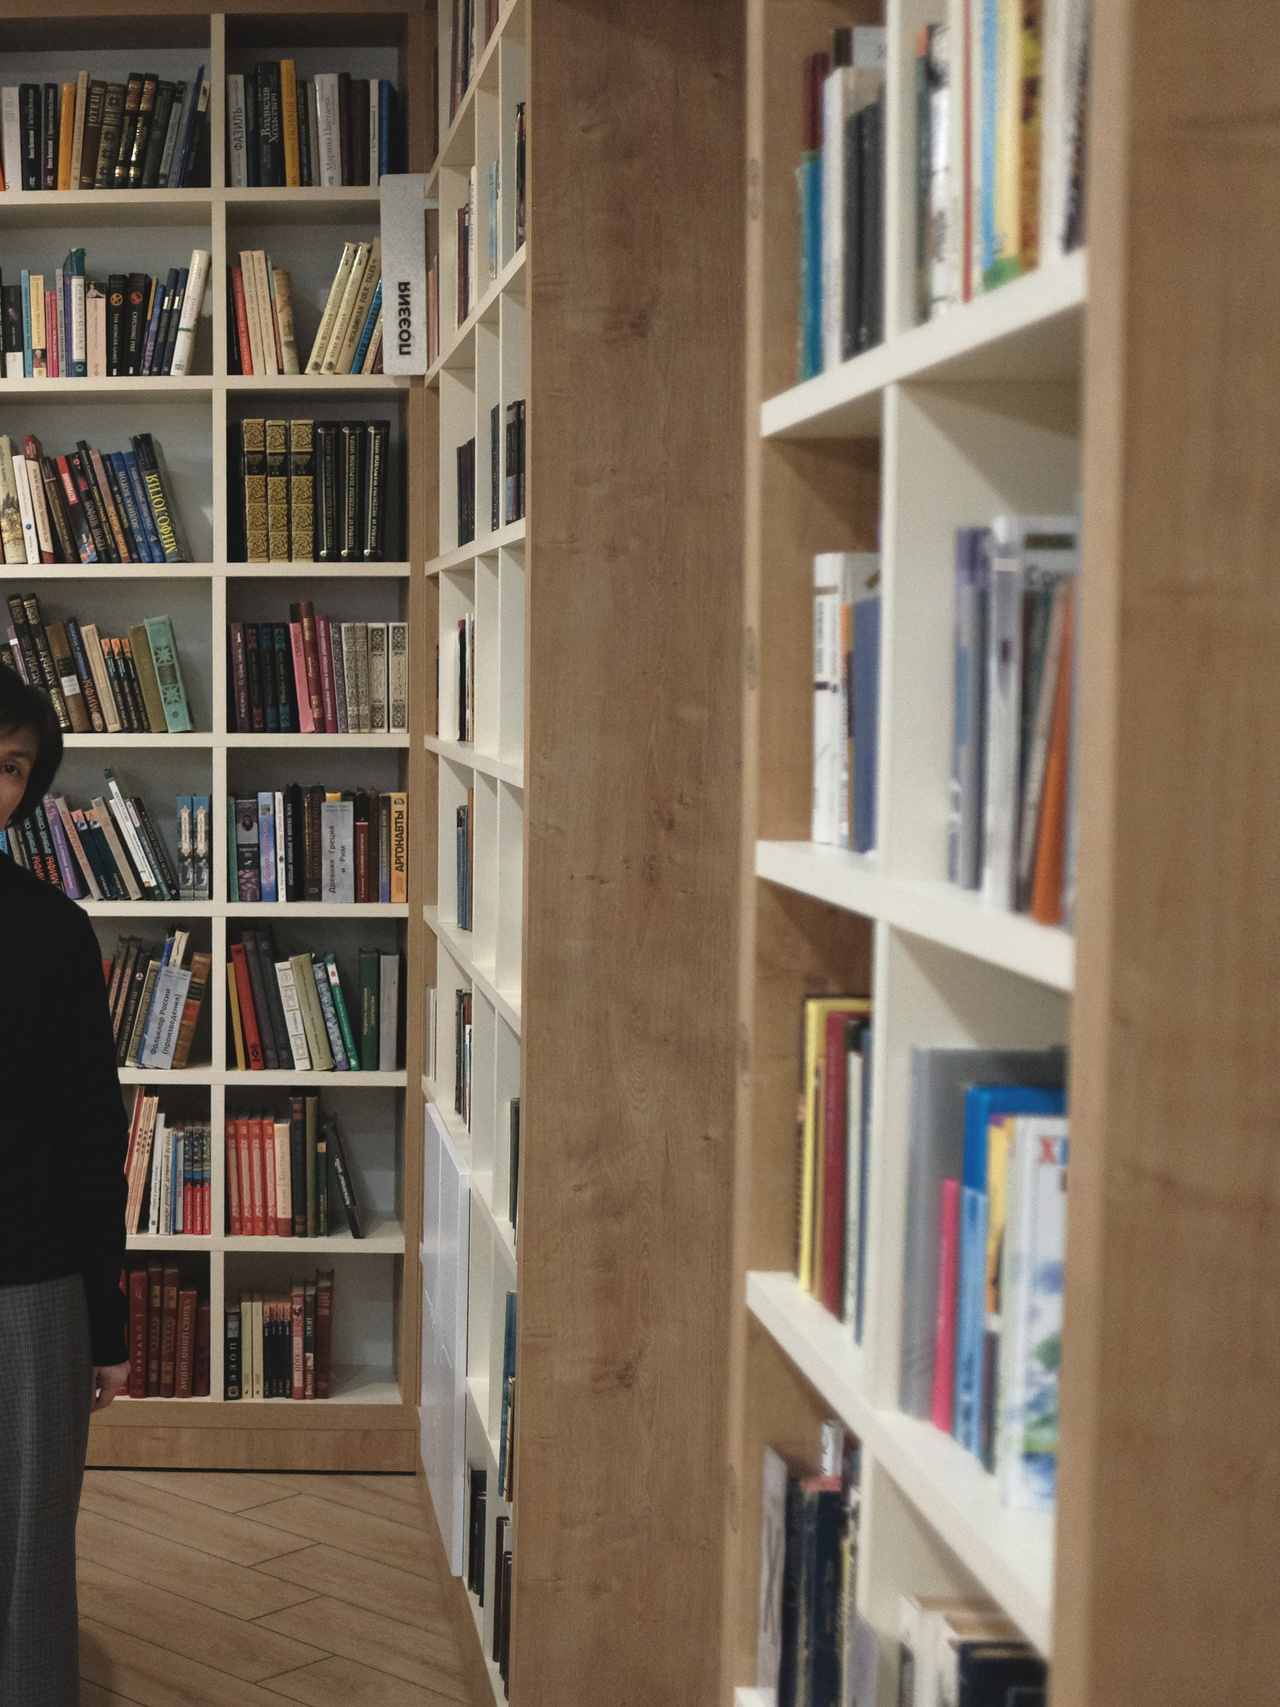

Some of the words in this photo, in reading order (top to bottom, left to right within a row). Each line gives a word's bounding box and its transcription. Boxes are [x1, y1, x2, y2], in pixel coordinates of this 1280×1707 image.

[232, 107, 244, 151] ФАЗИЛЬ
[260, 86, 272, 137] Владислав
[268, 92, 279, 143] Ходасевич
[324, 137, 334, 172] Марина
[398, 281, 412, 356] ПОЭЗИЯ
[129, 338, 137, 353] FIRE
[118, 471, 132, 497] БОГОВ
[84, 500, 101, 526] МИФОВ
[126, 499, 140, 530] ЗОДИАК
[141, 474, 179, 554] МИФОЛОГИЯ
[92, 527, 107, 551] ГЕРОИ
[81, 678, 100, 713] МИФЫ
[326, 825, 338, 854] Греция
[338, 845, 347, 863] Рим
[394, 810, 405, 873] АРГОНАВТЫ
[45, 855, 60, 884] МИФЫ
[327, 859, 339, 894] Древняя
[148, 1017, 167, 1055] Фольклор
[158, 987, 172, 1016] России
[160, 992, 183, 1055] (произведения)
